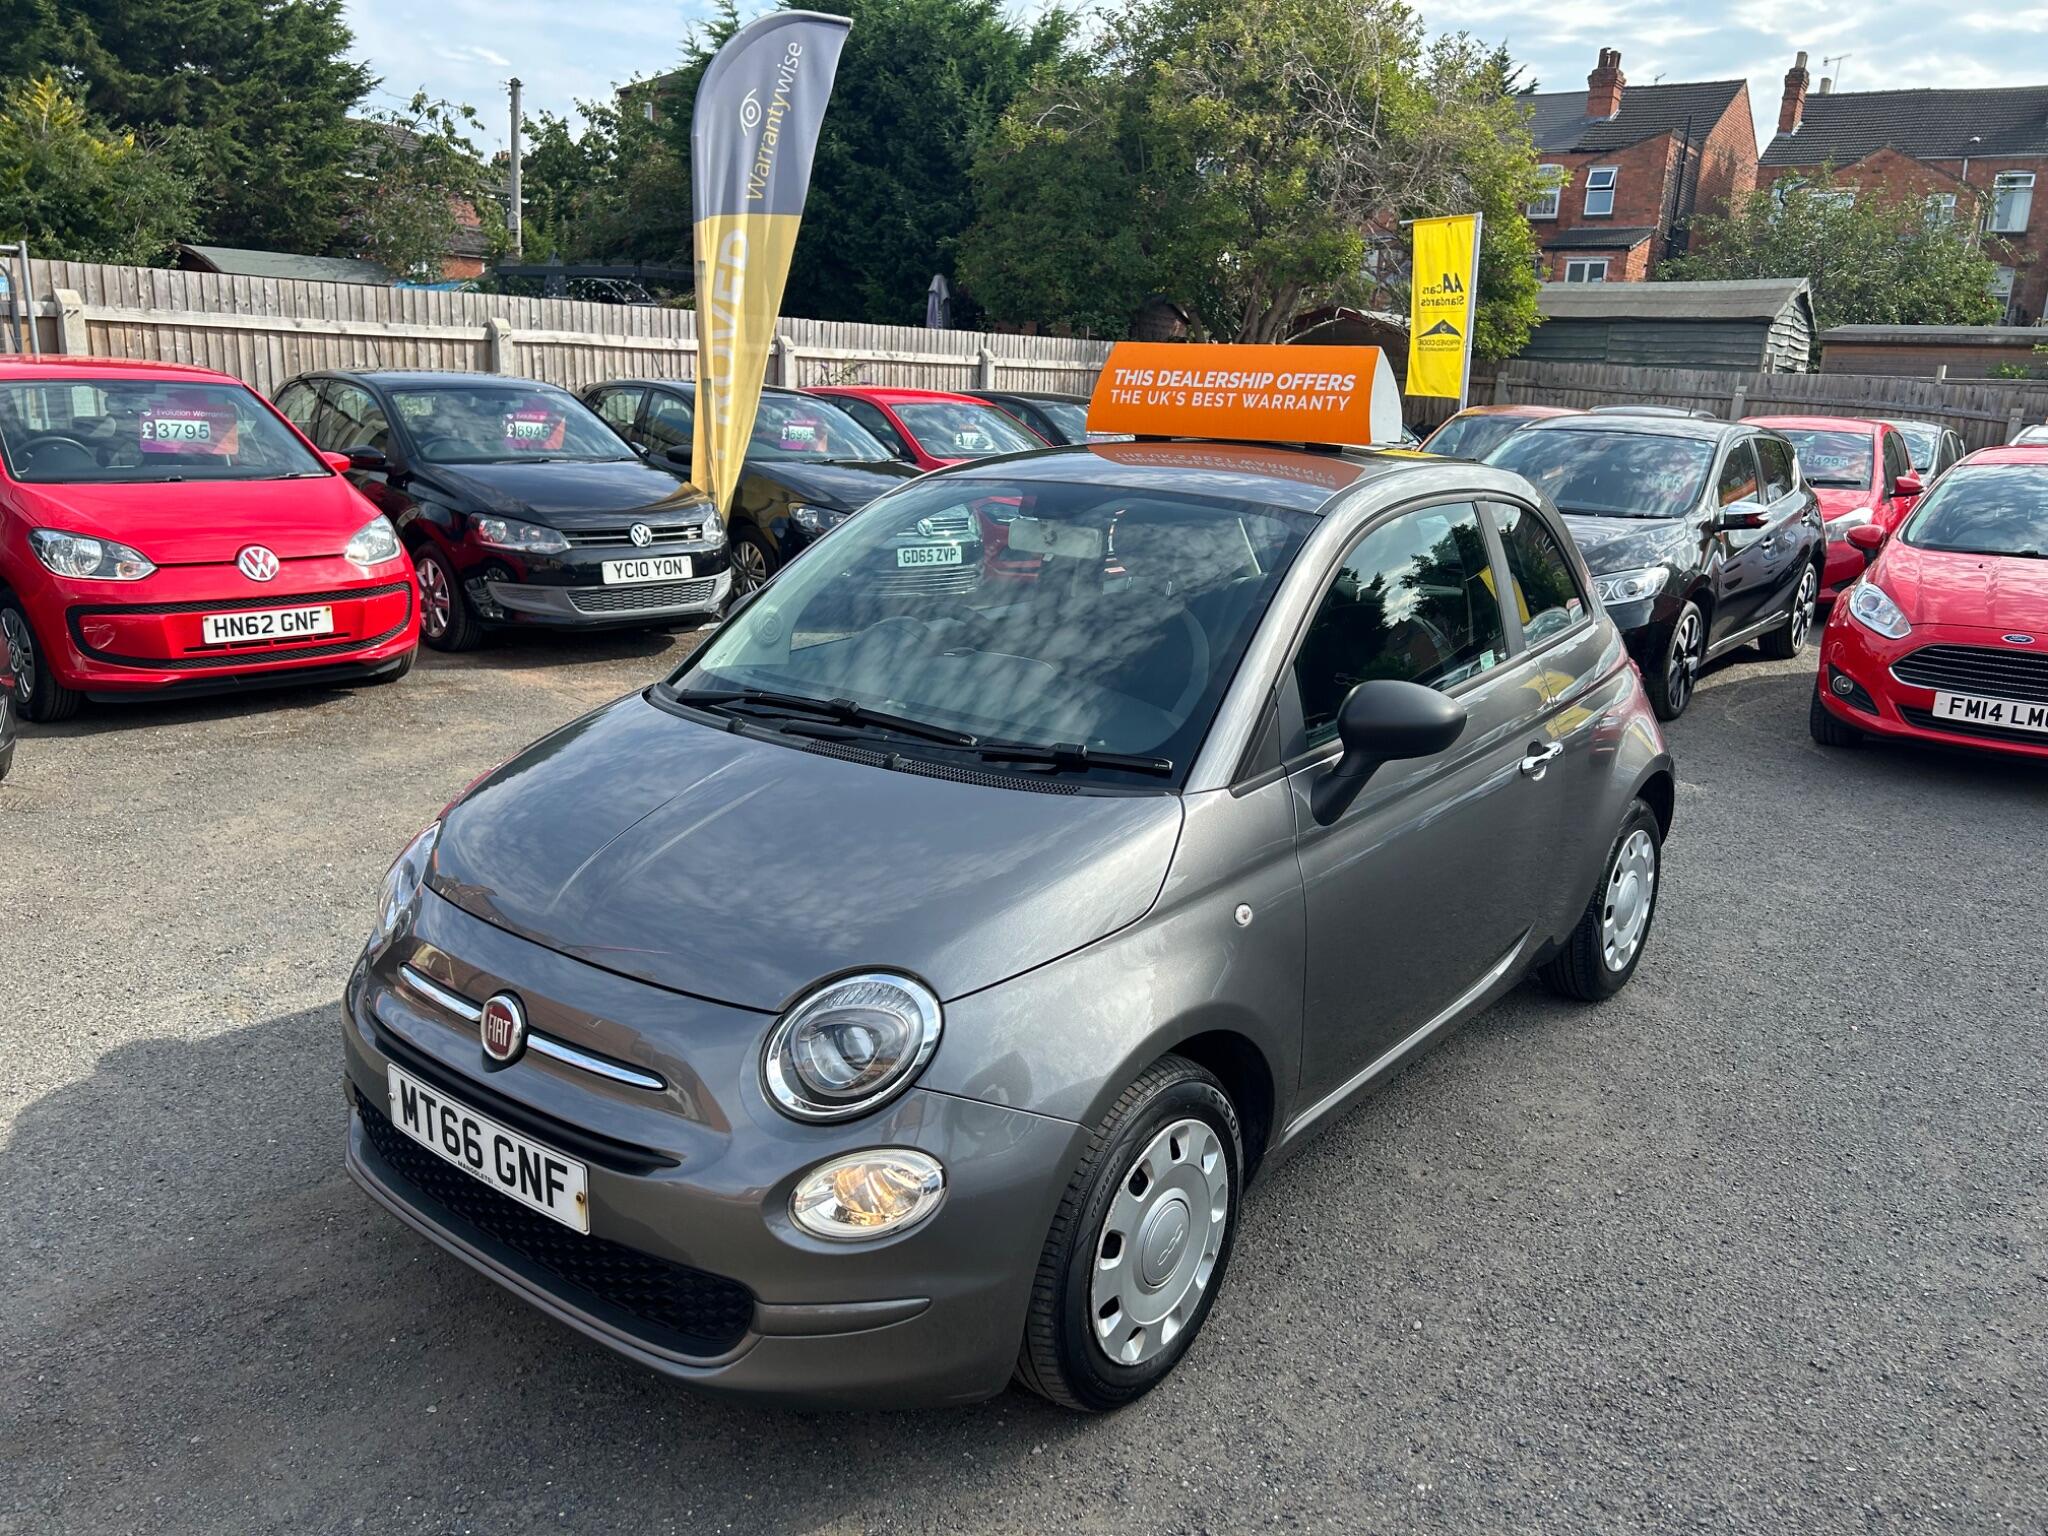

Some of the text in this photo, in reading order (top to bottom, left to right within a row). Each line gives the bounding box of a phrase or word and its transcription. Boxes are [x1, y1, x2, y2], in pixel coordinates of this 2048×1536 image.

[745, 41, 802, 200] Warrantywise
[1114, 369, 1357, 392] THIS DEALERSHIP OFFERS
[1111, 389, 1351, 412] THE UK'S BEST WARRANTY
[142, 420, 209, 440] £3795
[903, 548, 957, 564] GD65 ZVP
[613, 559, 683, 578] YC10 YON
[214, 609, 321, 639] HN62 GNF
[1949, 697, 2003, 722] FM14
[487, 1013, 511, 1047] FIAT
[400, 1079, 569, 1209] MT66 GNF
